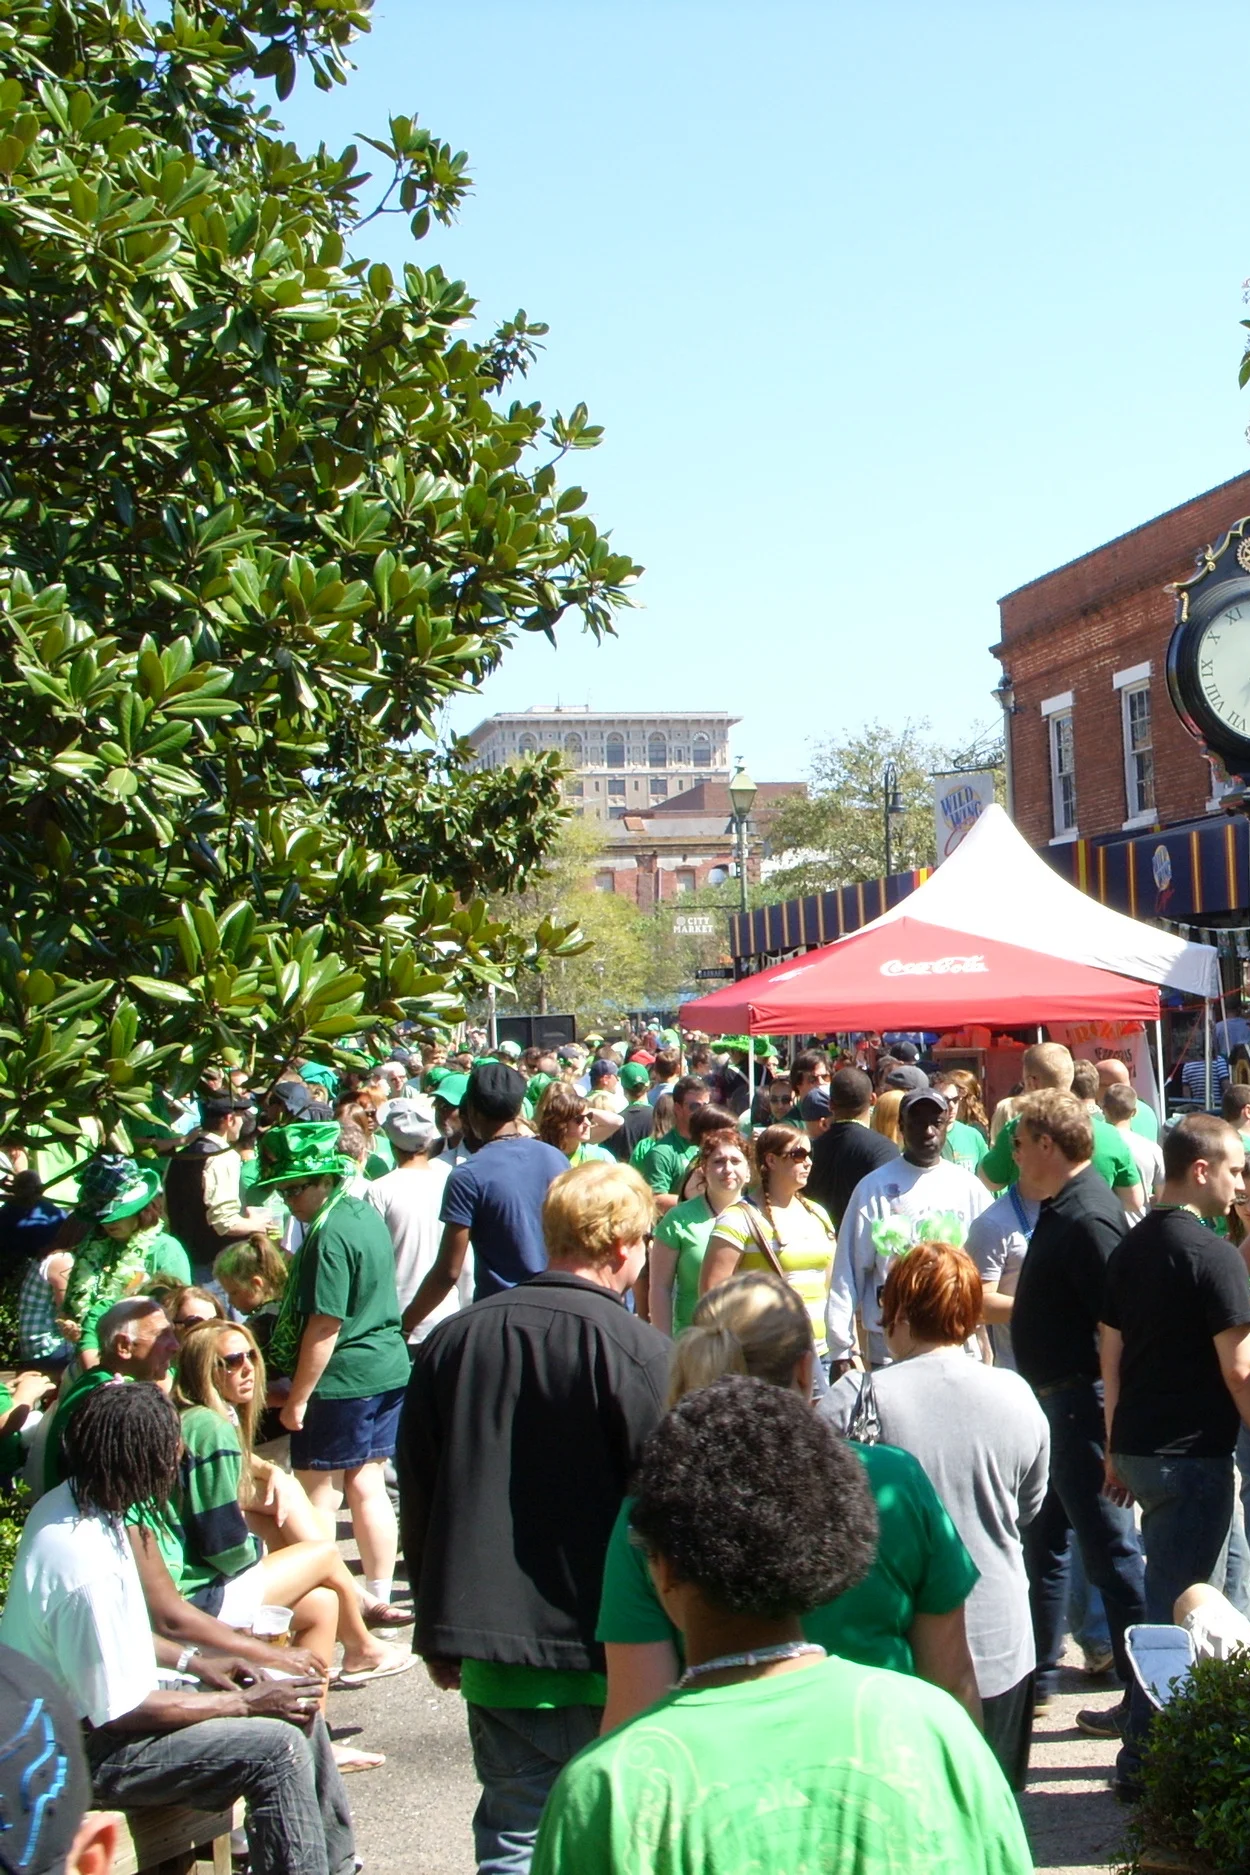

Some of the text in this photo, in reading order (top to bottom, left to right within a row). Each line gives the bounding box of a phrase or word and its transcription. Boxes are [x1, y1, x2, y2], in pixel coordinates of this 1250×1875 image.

[1224, 607, 1243, 625] XI
[1207, 630, 1221, 645] X
[1201, 659, 1213, 678] IX
[941, 786, 973, 816] WILD
[951, 801, 982, 828] WING
[673, 925, 713, 933] MARKET
[687, 917, 710, 925] CITY
